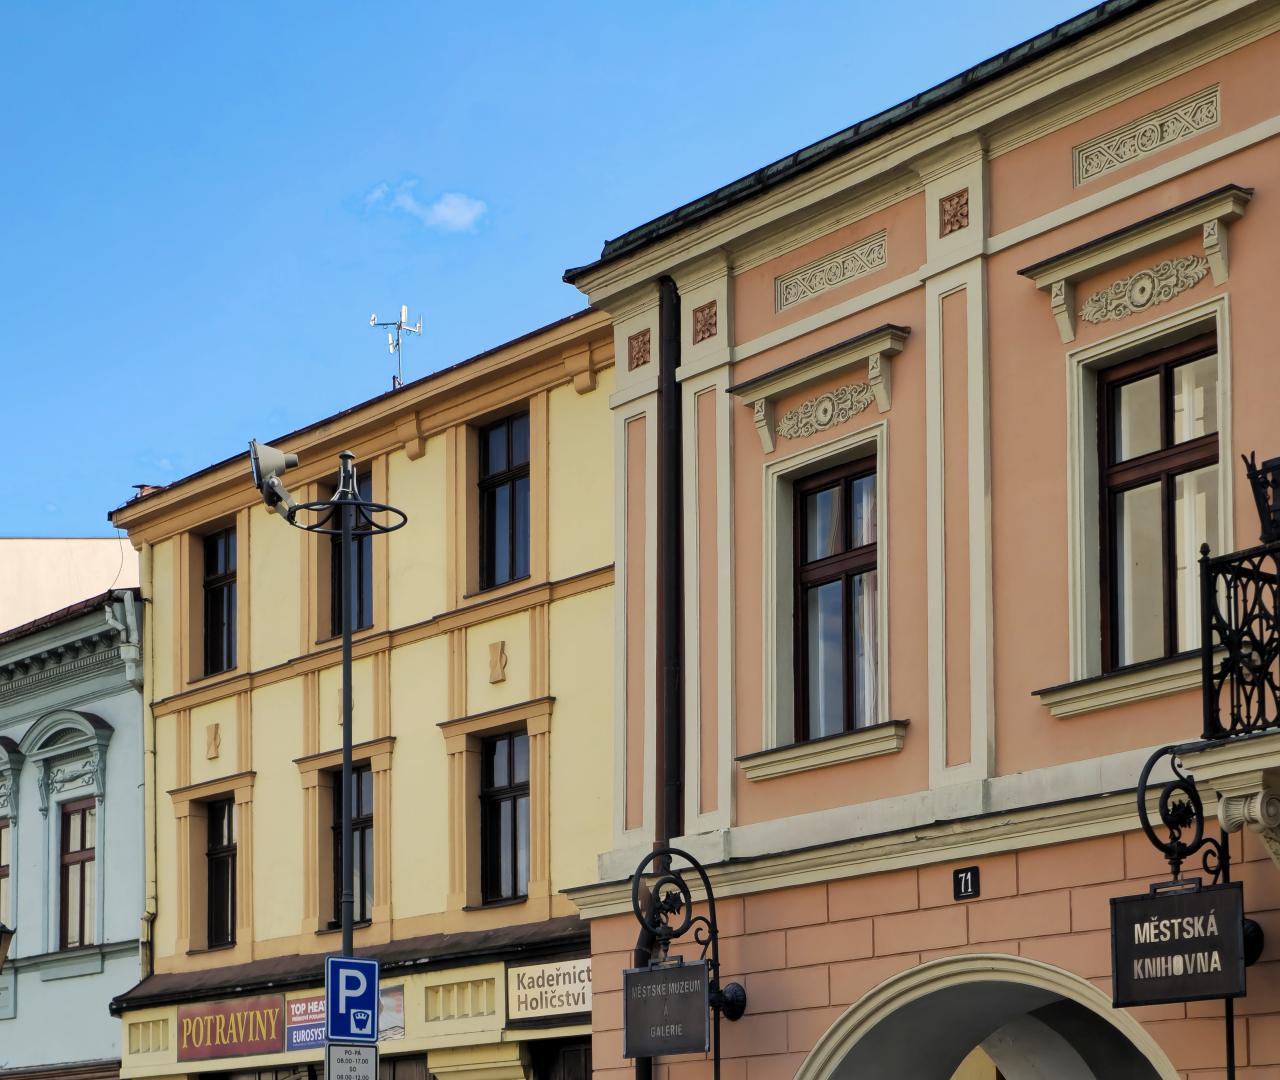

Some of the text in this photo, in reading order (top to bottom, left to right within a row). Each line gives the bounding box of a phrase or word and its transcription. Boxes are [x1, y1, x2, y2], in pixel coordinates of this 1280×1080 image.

[958, 871, 972, 893] 71
[1134, 908, 1219, 945] MĚSTSKÁ
[516, 965, 592, 991] Kadeřnict
[1133, 950, 1222, 980] KNIHOVNA
[338, 968, 368, 1014] P
[517, 985, 586, 1012] Holičství
[668, 979, 701, 995] MUZEUM
[290, 1003, 306, 1016] TOP
[182, 1007, 280, 1049] POTRAVINY
[292, 1028, 325, 1043] EUROSYST
[650, 1023, 683, 1038] GALERIE
